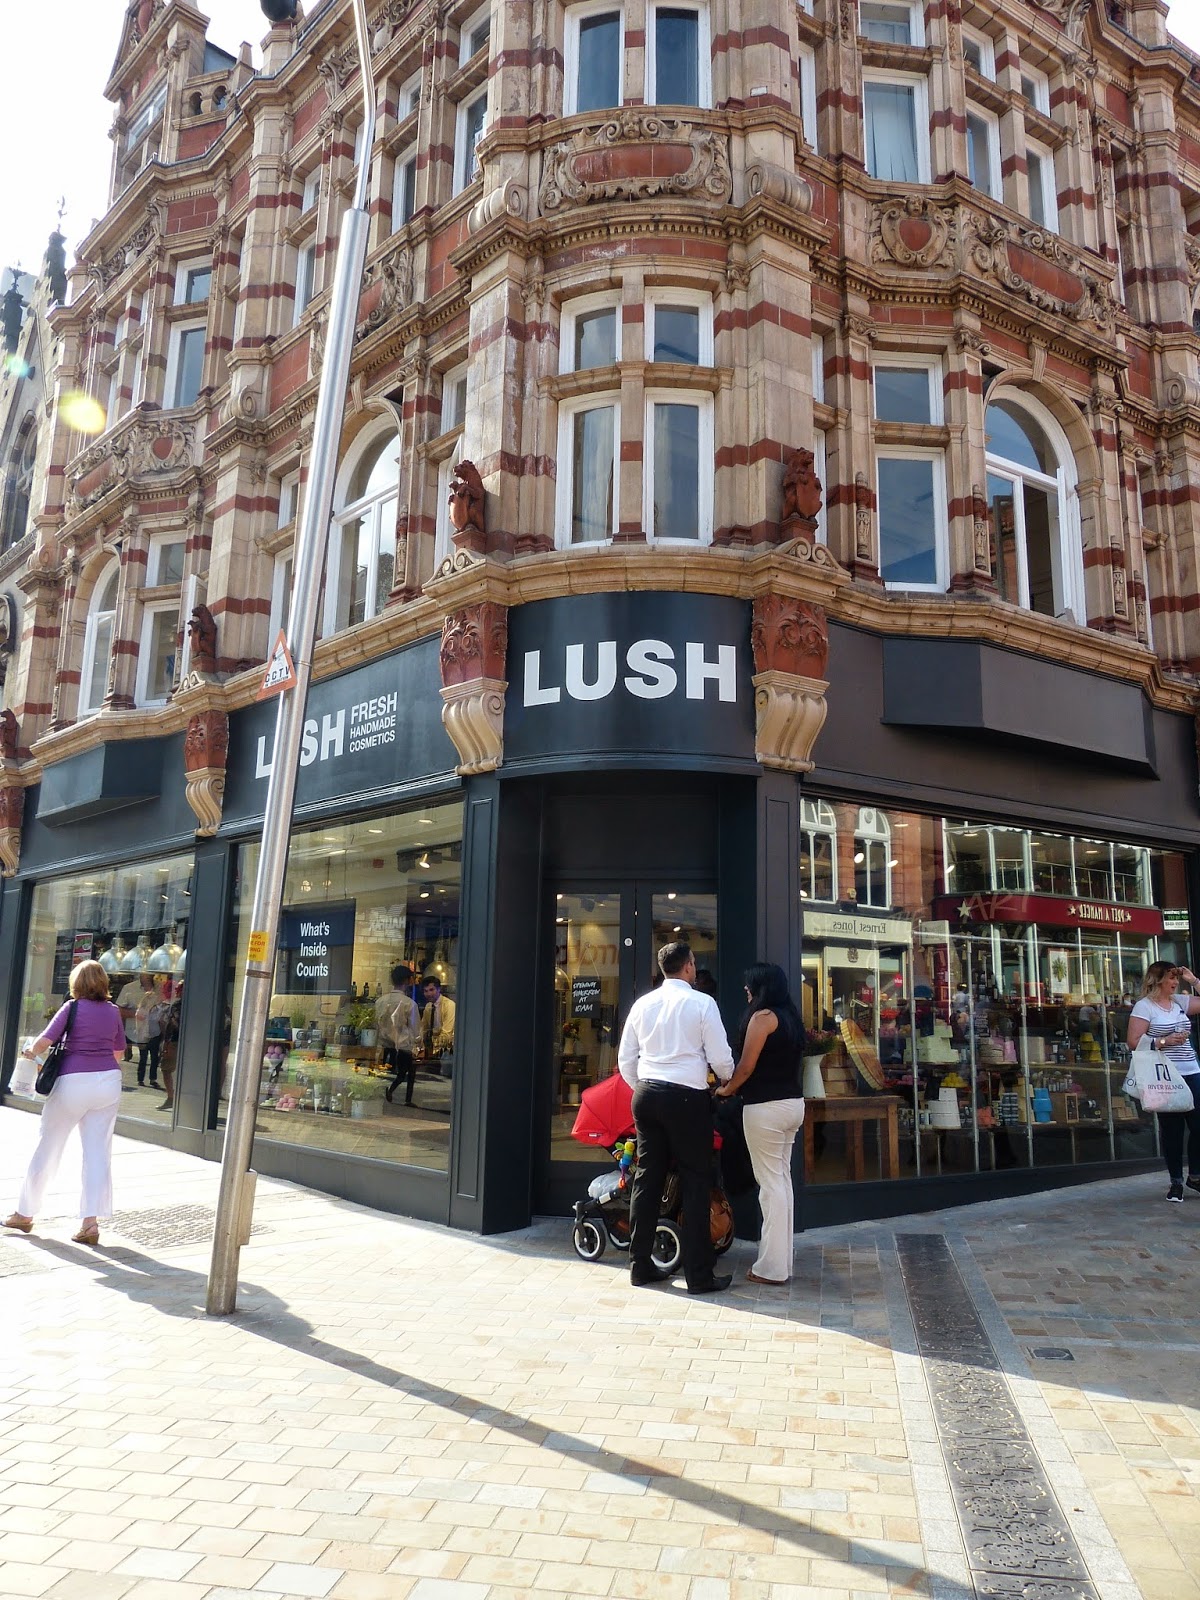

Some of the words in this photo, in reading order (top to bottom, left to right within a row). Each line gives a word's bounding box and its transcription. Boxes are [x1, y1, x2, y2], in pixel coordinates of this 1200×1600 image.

[265, 665, 291, 683] CCTV
[523, 639, 737, 707] LUSH
[350, 691, 398, 725] FRESH
[349, 715, 396, 739] HANDMADE
[255, 709, 346, 779] LSH
[349, 730, 396, 753] COSMETICS
[300, 921, 330, 937] What's
[300, 942, 327, 957] Inside
[296, 962, 329, 977] Counts
